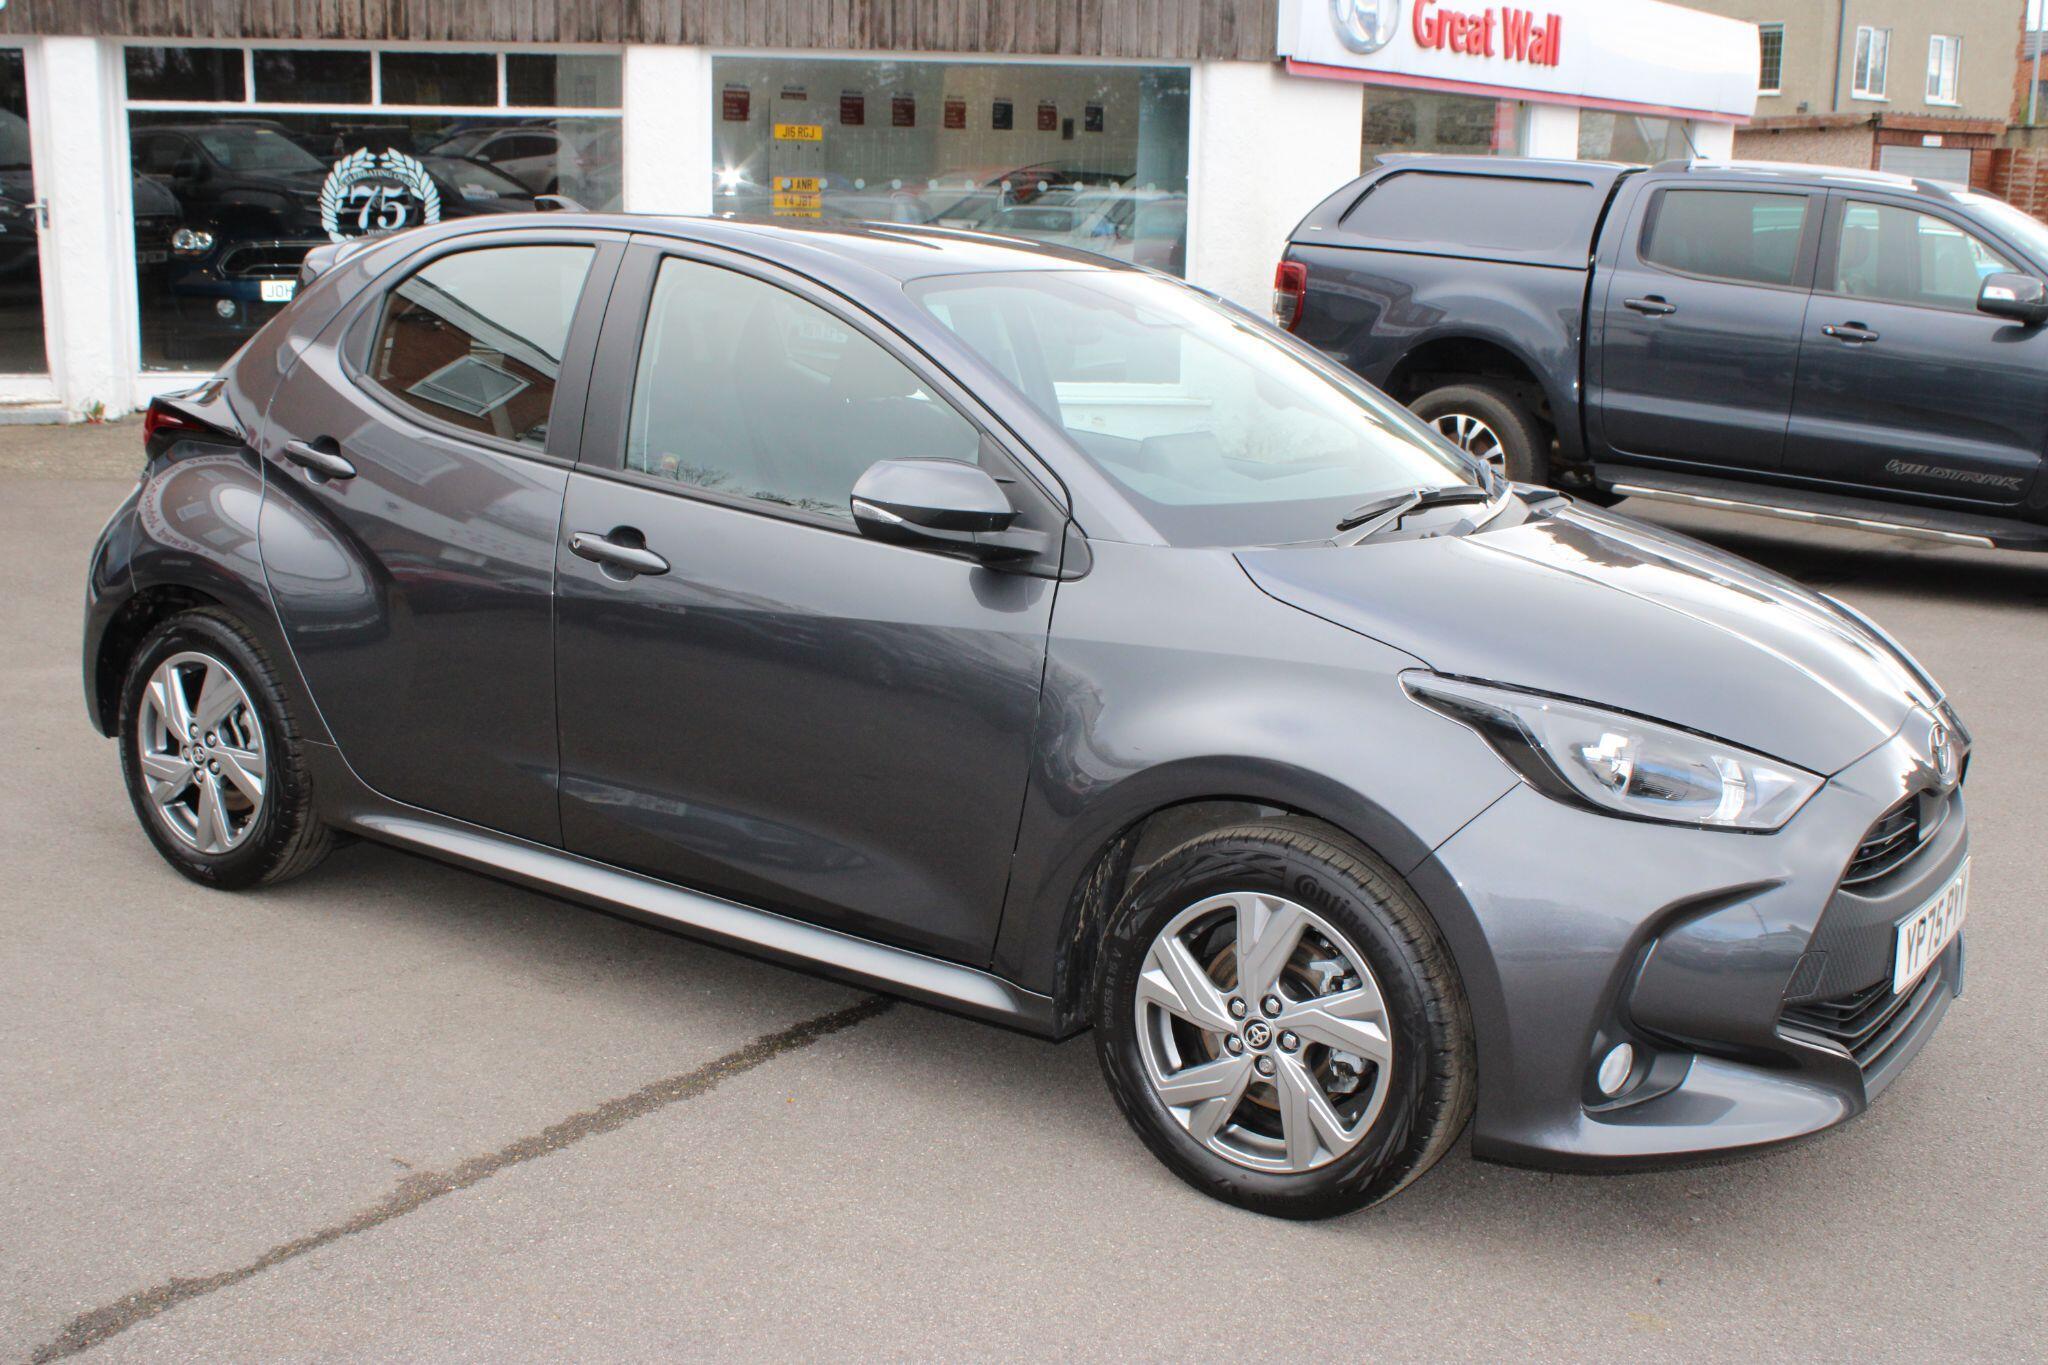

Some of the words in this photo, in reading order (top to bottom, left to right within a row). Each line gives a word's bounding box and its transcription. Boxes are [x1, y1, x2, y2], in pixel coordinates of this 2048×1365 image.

[1412, 0, 1496, 58] Great
[1502, 6, 1562, 67] Wall
[349, 185, 407, 230] 75
[1885, 459, 2024, 491] WILDTRAK
[1907, 898, 1944, 975] YP75
